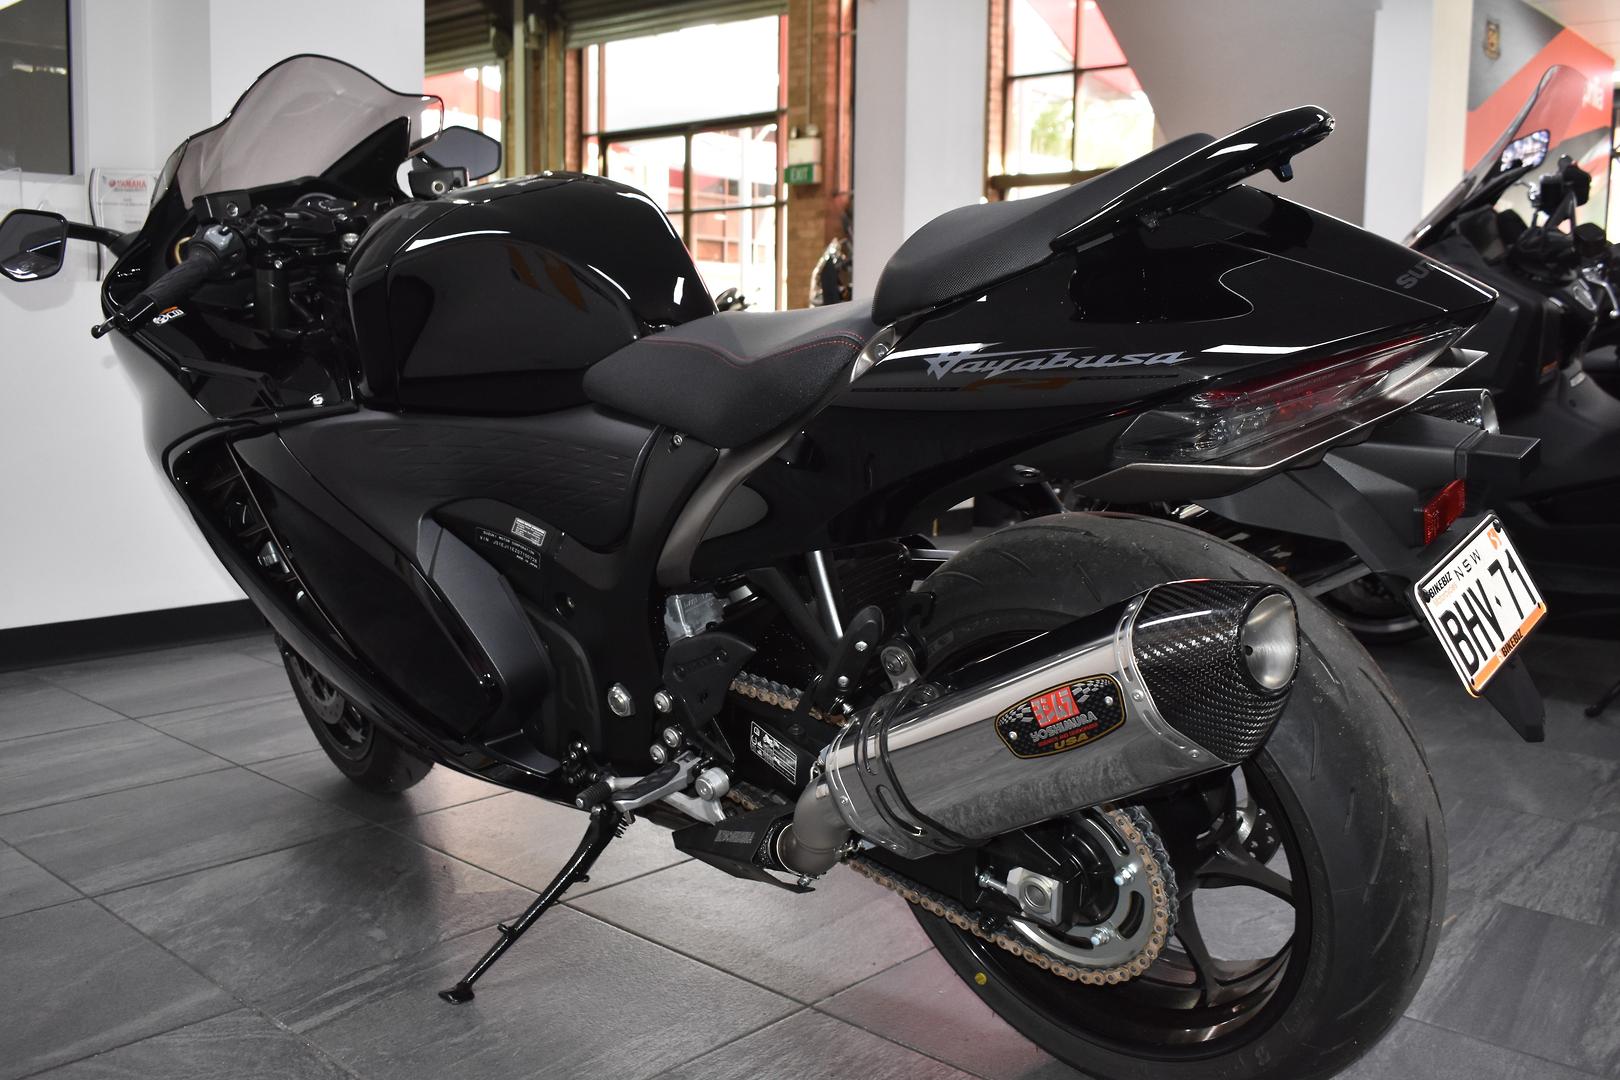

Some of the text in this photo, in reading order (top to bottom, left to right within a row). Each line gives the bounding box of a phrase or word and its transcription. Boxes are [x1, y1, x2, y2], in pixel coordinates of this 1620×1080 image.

[1428, 571, 1453, 599] BIKEBIZ
[1501, 628, 1523, 657] BIKEBIZ
[1029, 710, 1098, 743] YOSHIMURA
[1053, 733, 1089, 750] USA
